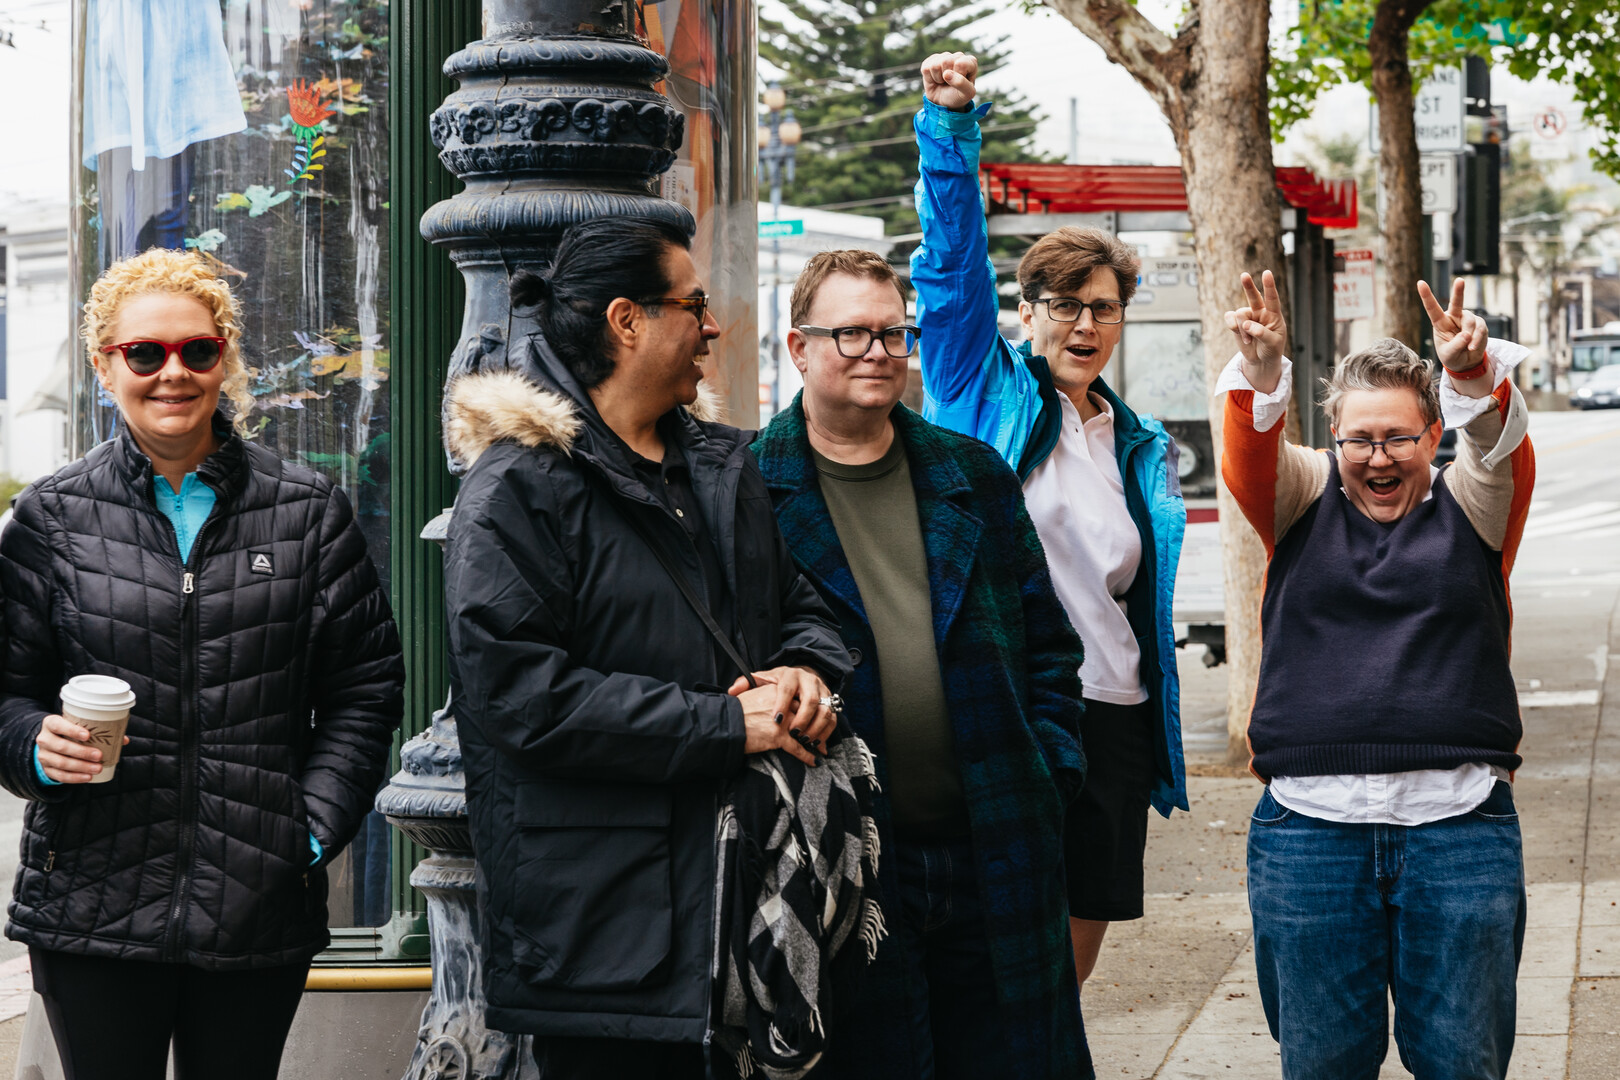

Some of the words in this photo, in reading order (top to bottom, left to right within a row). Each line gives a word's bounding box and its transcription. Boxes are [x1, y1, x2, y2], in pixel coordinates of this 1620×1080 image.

[1420, 97, 1441, 114] ST
[1416, 125, 1458, 140] RIGHT
[1420, 162, 1446, 178] EPT
[760, 223, 793, 234] astro
[1156, 262, 1178, 270] STOP
